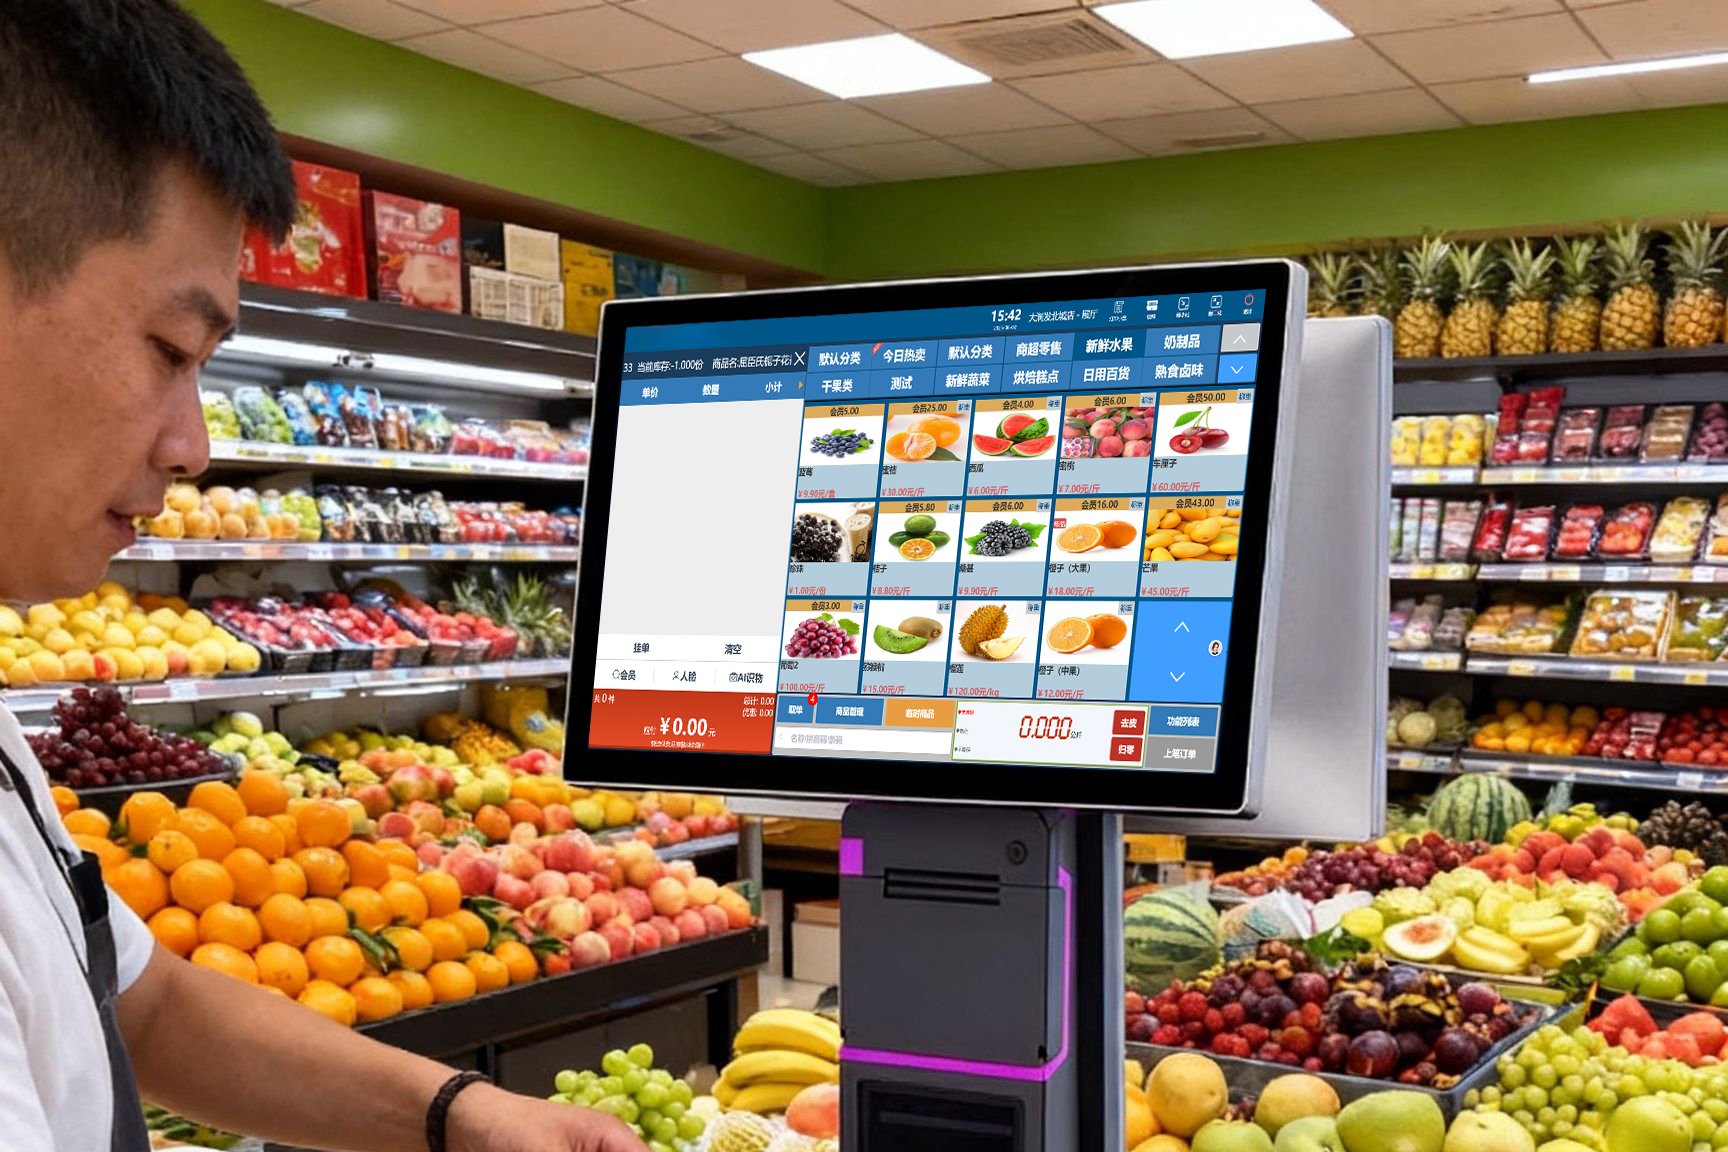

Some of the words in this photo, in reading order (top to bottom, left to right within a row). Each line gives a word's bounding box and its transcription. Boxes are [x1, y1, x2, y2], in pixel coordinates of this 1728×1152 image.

[991, 309, 1022, 322] 15:42
[1086, 337, 1133, 354] 新鲜水果
[1164, 334, 1200, 350] 奶制品
[947, 344, 993, 361] 默认分类
[1016, 341, 1062, 357] 商超零售
[818, 351, 861, 366] 默认分类
[883, 348, 926, 363] 今日热卖
[1013, 369, 1059, 385] 烘焙糕点
[1083, 366, 1130, 383] 日用百货
[1155, 363, 1204, 380] 熟食卤味
[890, 376, 913, 391] 测试
[945, 372, 990, 388] 新鲜蔬菜
[642, 387, 658, 398] 单价
[702, 384, 719, 396] 数量
[765, 381, 782, 393] 小计
[1094, 396, 1127, 407] 会员6.00
[1187, 393, 1226, 404] 会员50.00
[912, 404, 947, 414] 会员25.00
[1002, 400, 1034, 410] 会员4.00
[830, 407, 859, 417] 会员5.00
[1153, 458, 1177, 468] 车厘子
[905, 503, 935, 513] 会员5.80
[992, 501, 1024, 512] 会员6.00
[1081, 500, 1119, 510] 会员16.00
[1176, 498, 1215, 508] 会员43.00
[1142, 563, 1159, 573] 芒果
[811, 601, 840, 611] 会员3.00
[633, 642, 650, 654] 挂单
[724, 644, 742, 655] 清空
[620, 670, 636, 681] 会员
[680, 671, 697, 682] 人脸
[737, 672, 764, 684] AI识物
[905, 708, 935, 719] 临时商品
[1120, 717, 1138, 729] 去皮
[1167, 716, 1200, 727] 功能列表
[708, 728, 716, 738] 元
[1019, 715, 1073, 740] 0.000
[1118, 744, 1135, 755] 归零
[1163, 748, 1197, 759] 上笔订单
